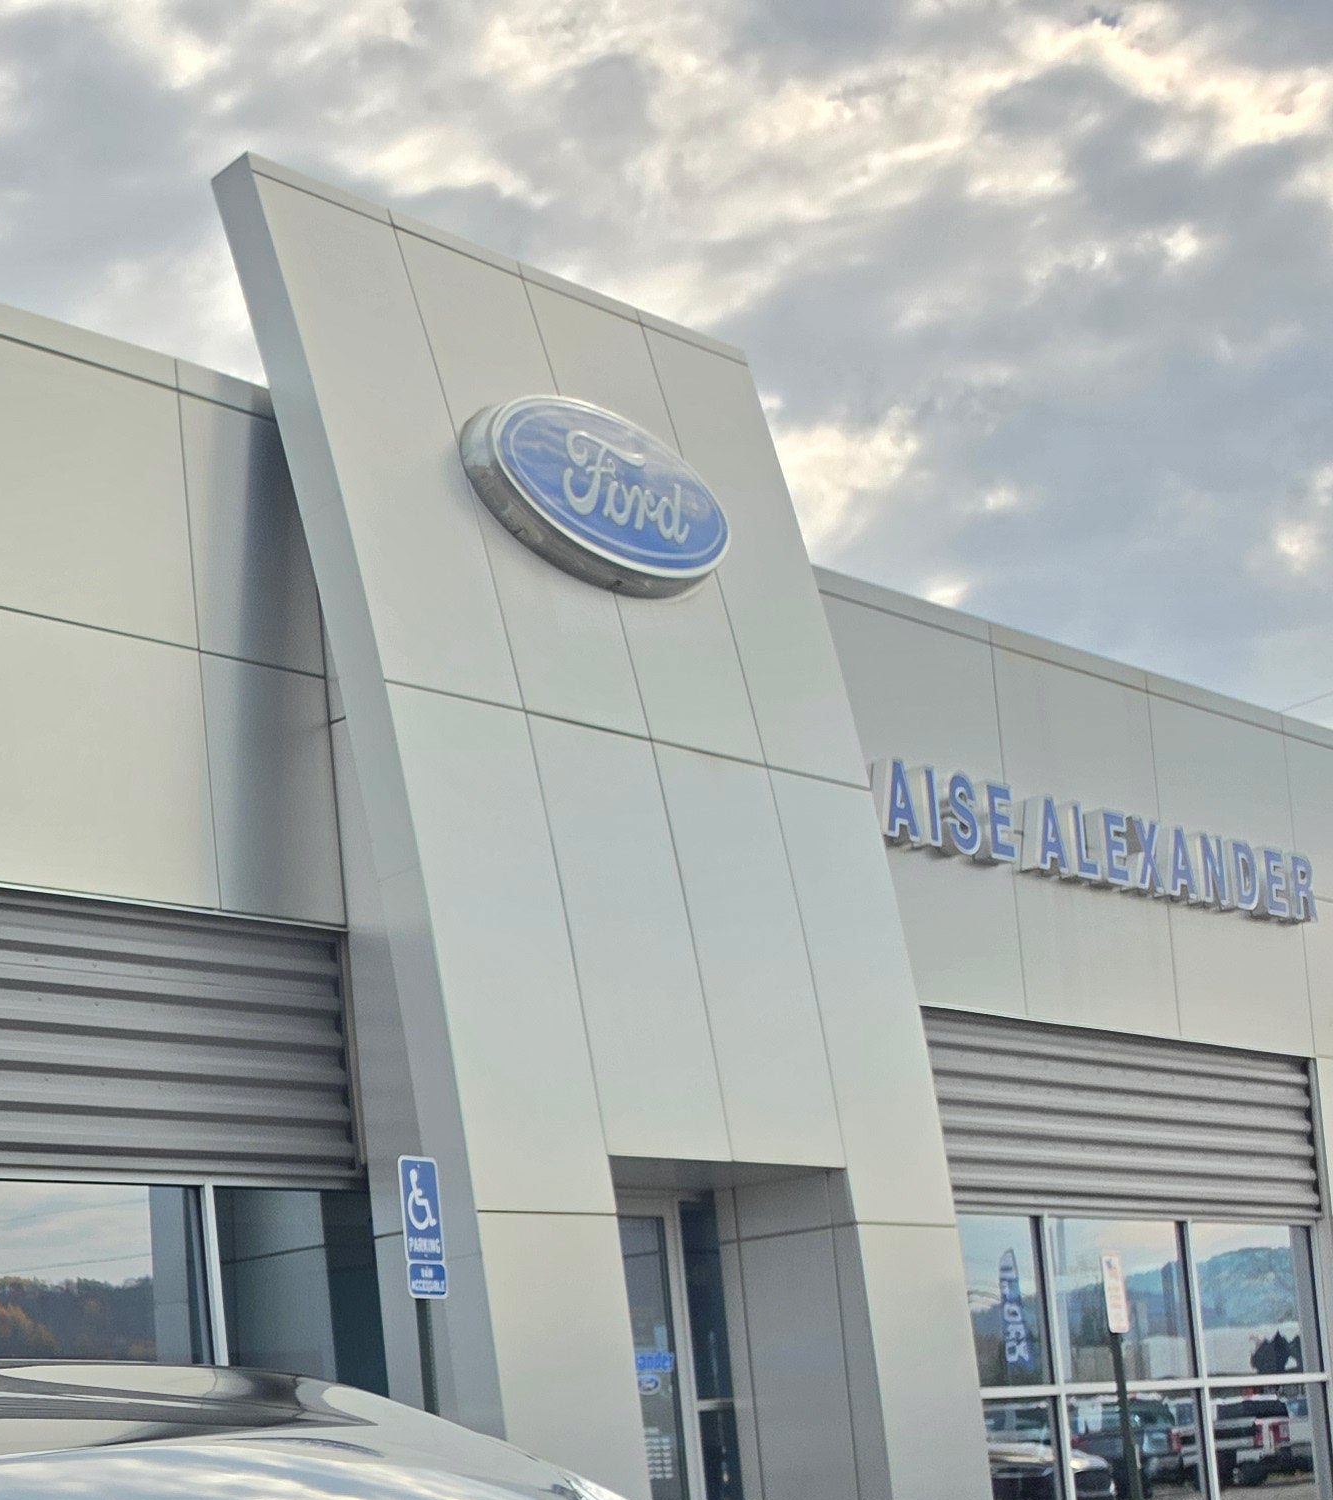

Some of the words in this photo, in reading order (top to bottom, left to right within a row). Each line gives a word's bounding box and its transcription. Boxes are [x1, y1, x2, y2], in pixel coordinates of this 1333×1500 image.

[563, 429, 690, 545] Ford
[878, 757, 1017, 862] AISE
[1033, 796, 1318, 922] ALEXANDER
[408, 1237, 441, 1254] PARKING
